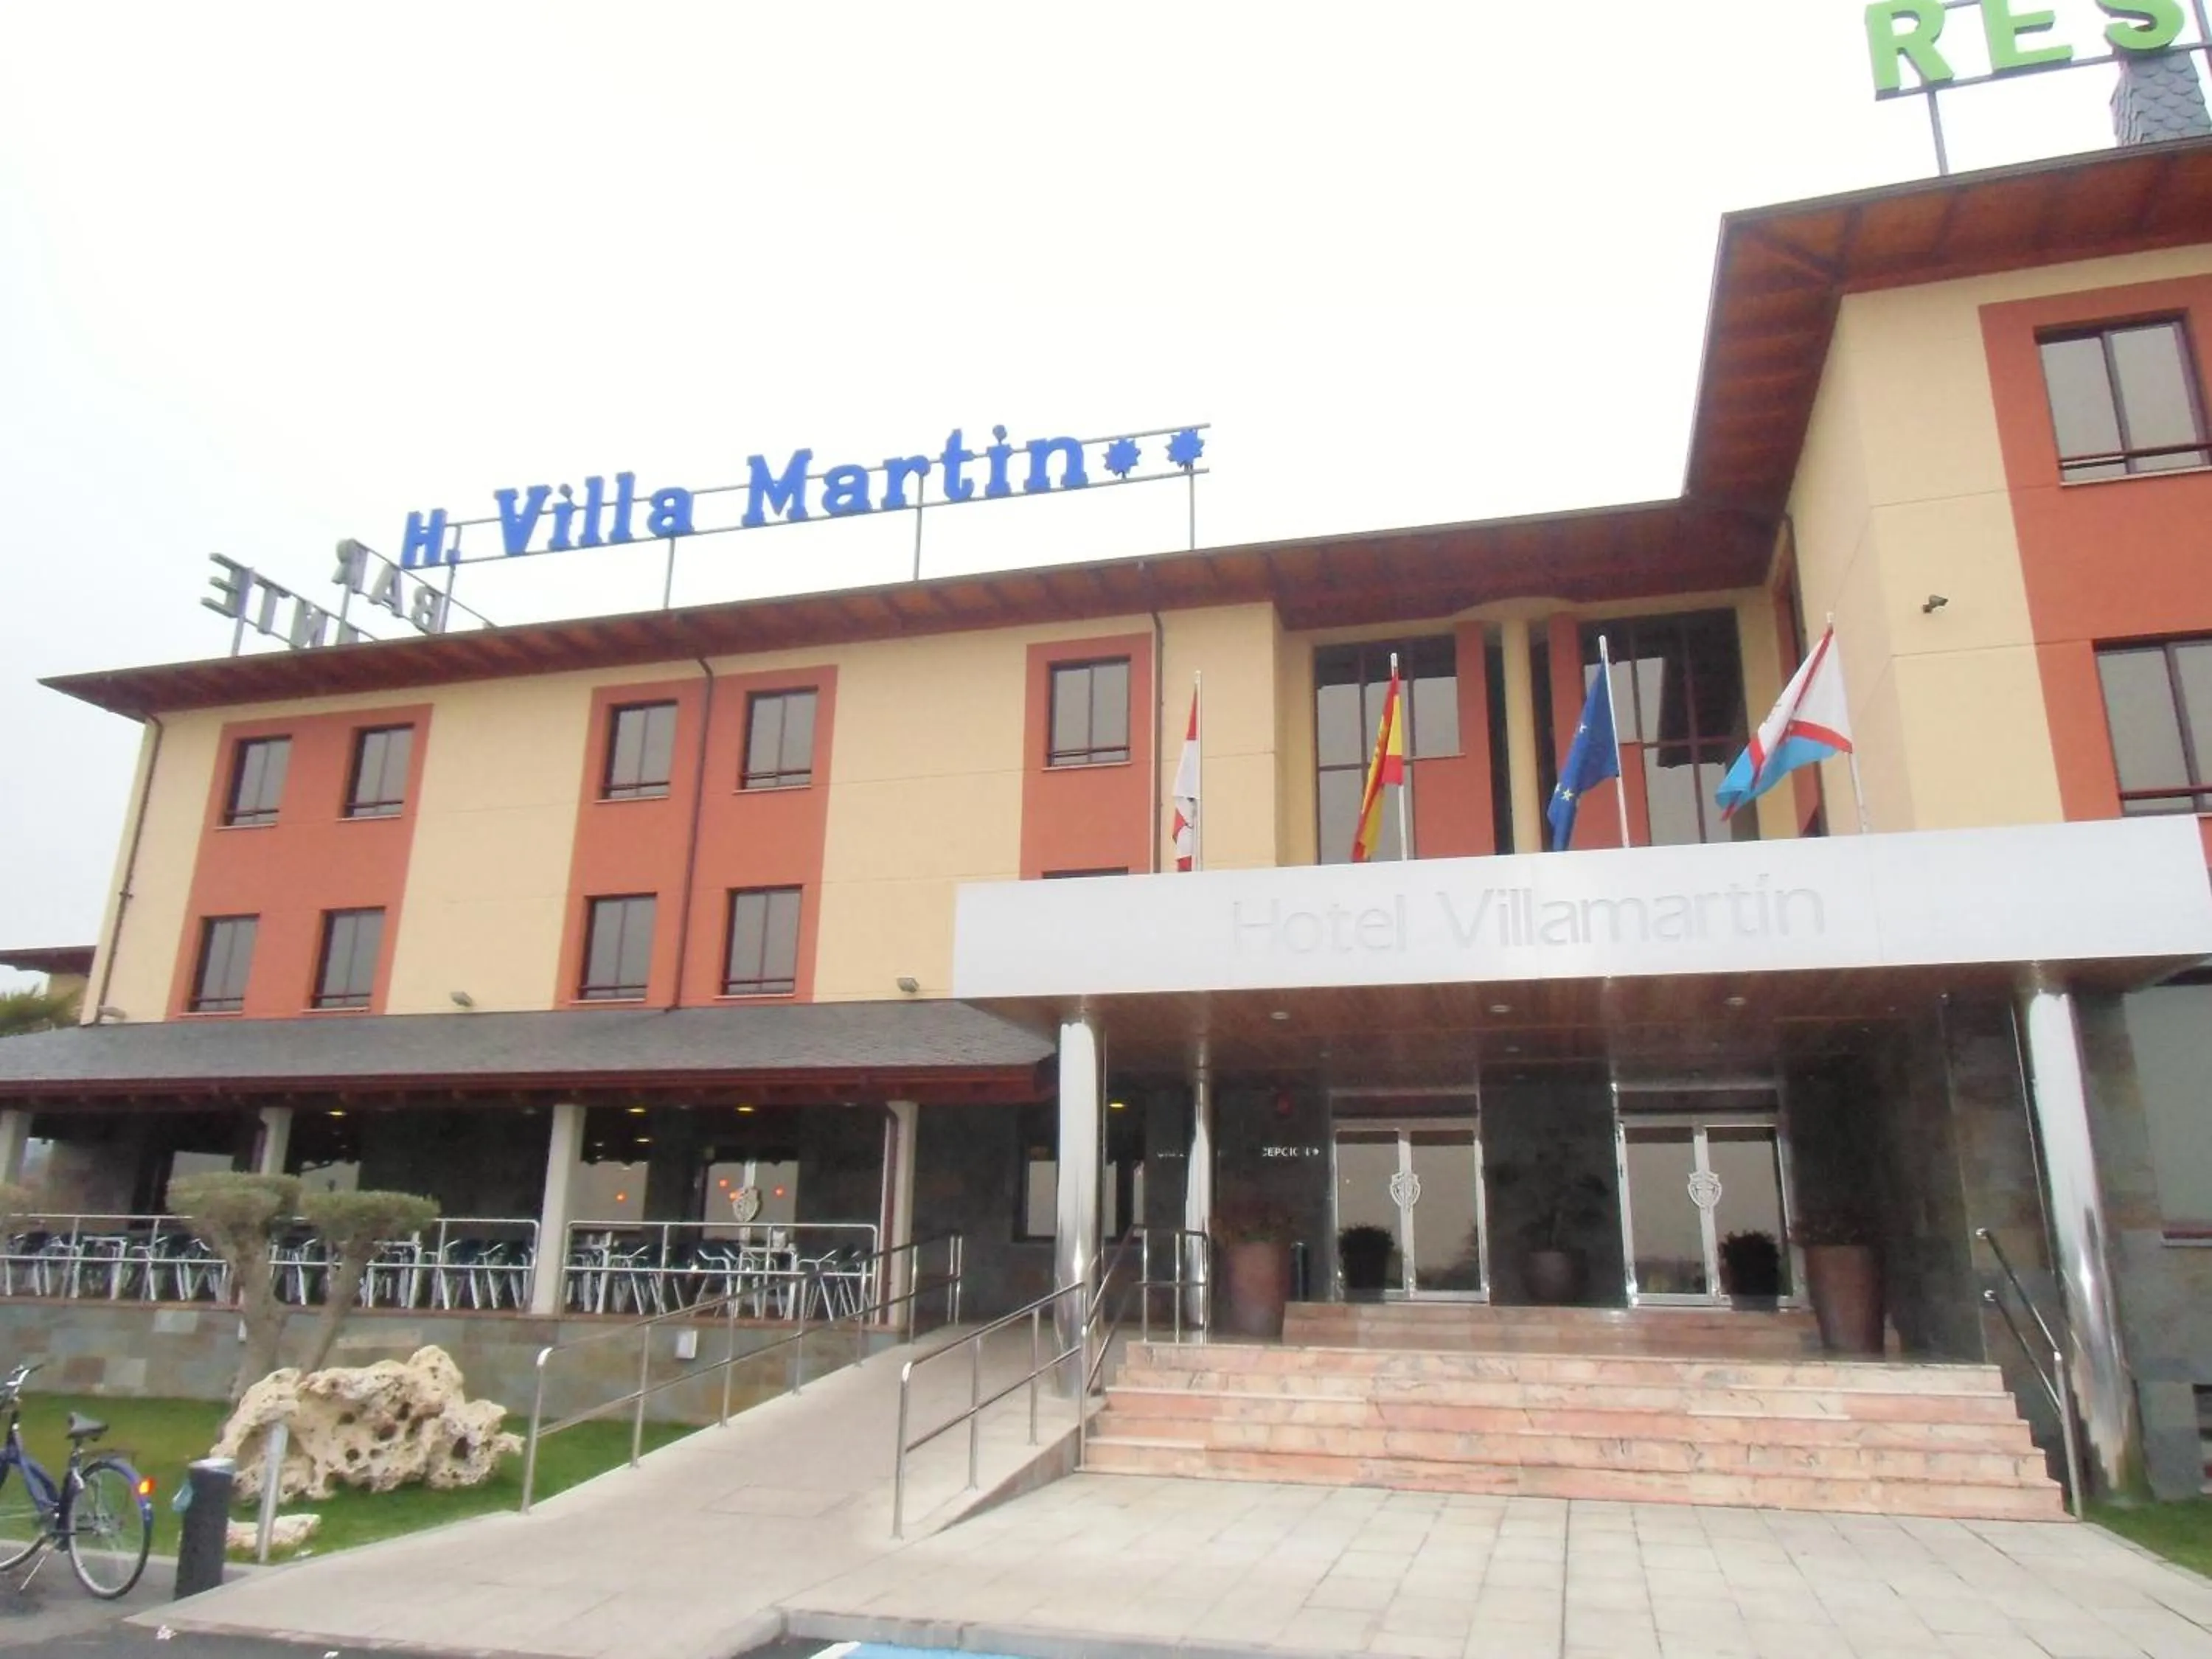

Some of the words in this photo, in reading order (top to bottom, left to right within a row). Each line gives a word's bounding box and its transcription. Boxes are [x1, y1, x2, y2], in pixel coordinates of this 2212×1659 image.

[494, 470, 695, 556] Villa
[740, 424, 1090, 528] Martin
[1232, 893, 1408, 954] Hotel
[1435, 872, 1826, 950] Villamartín
